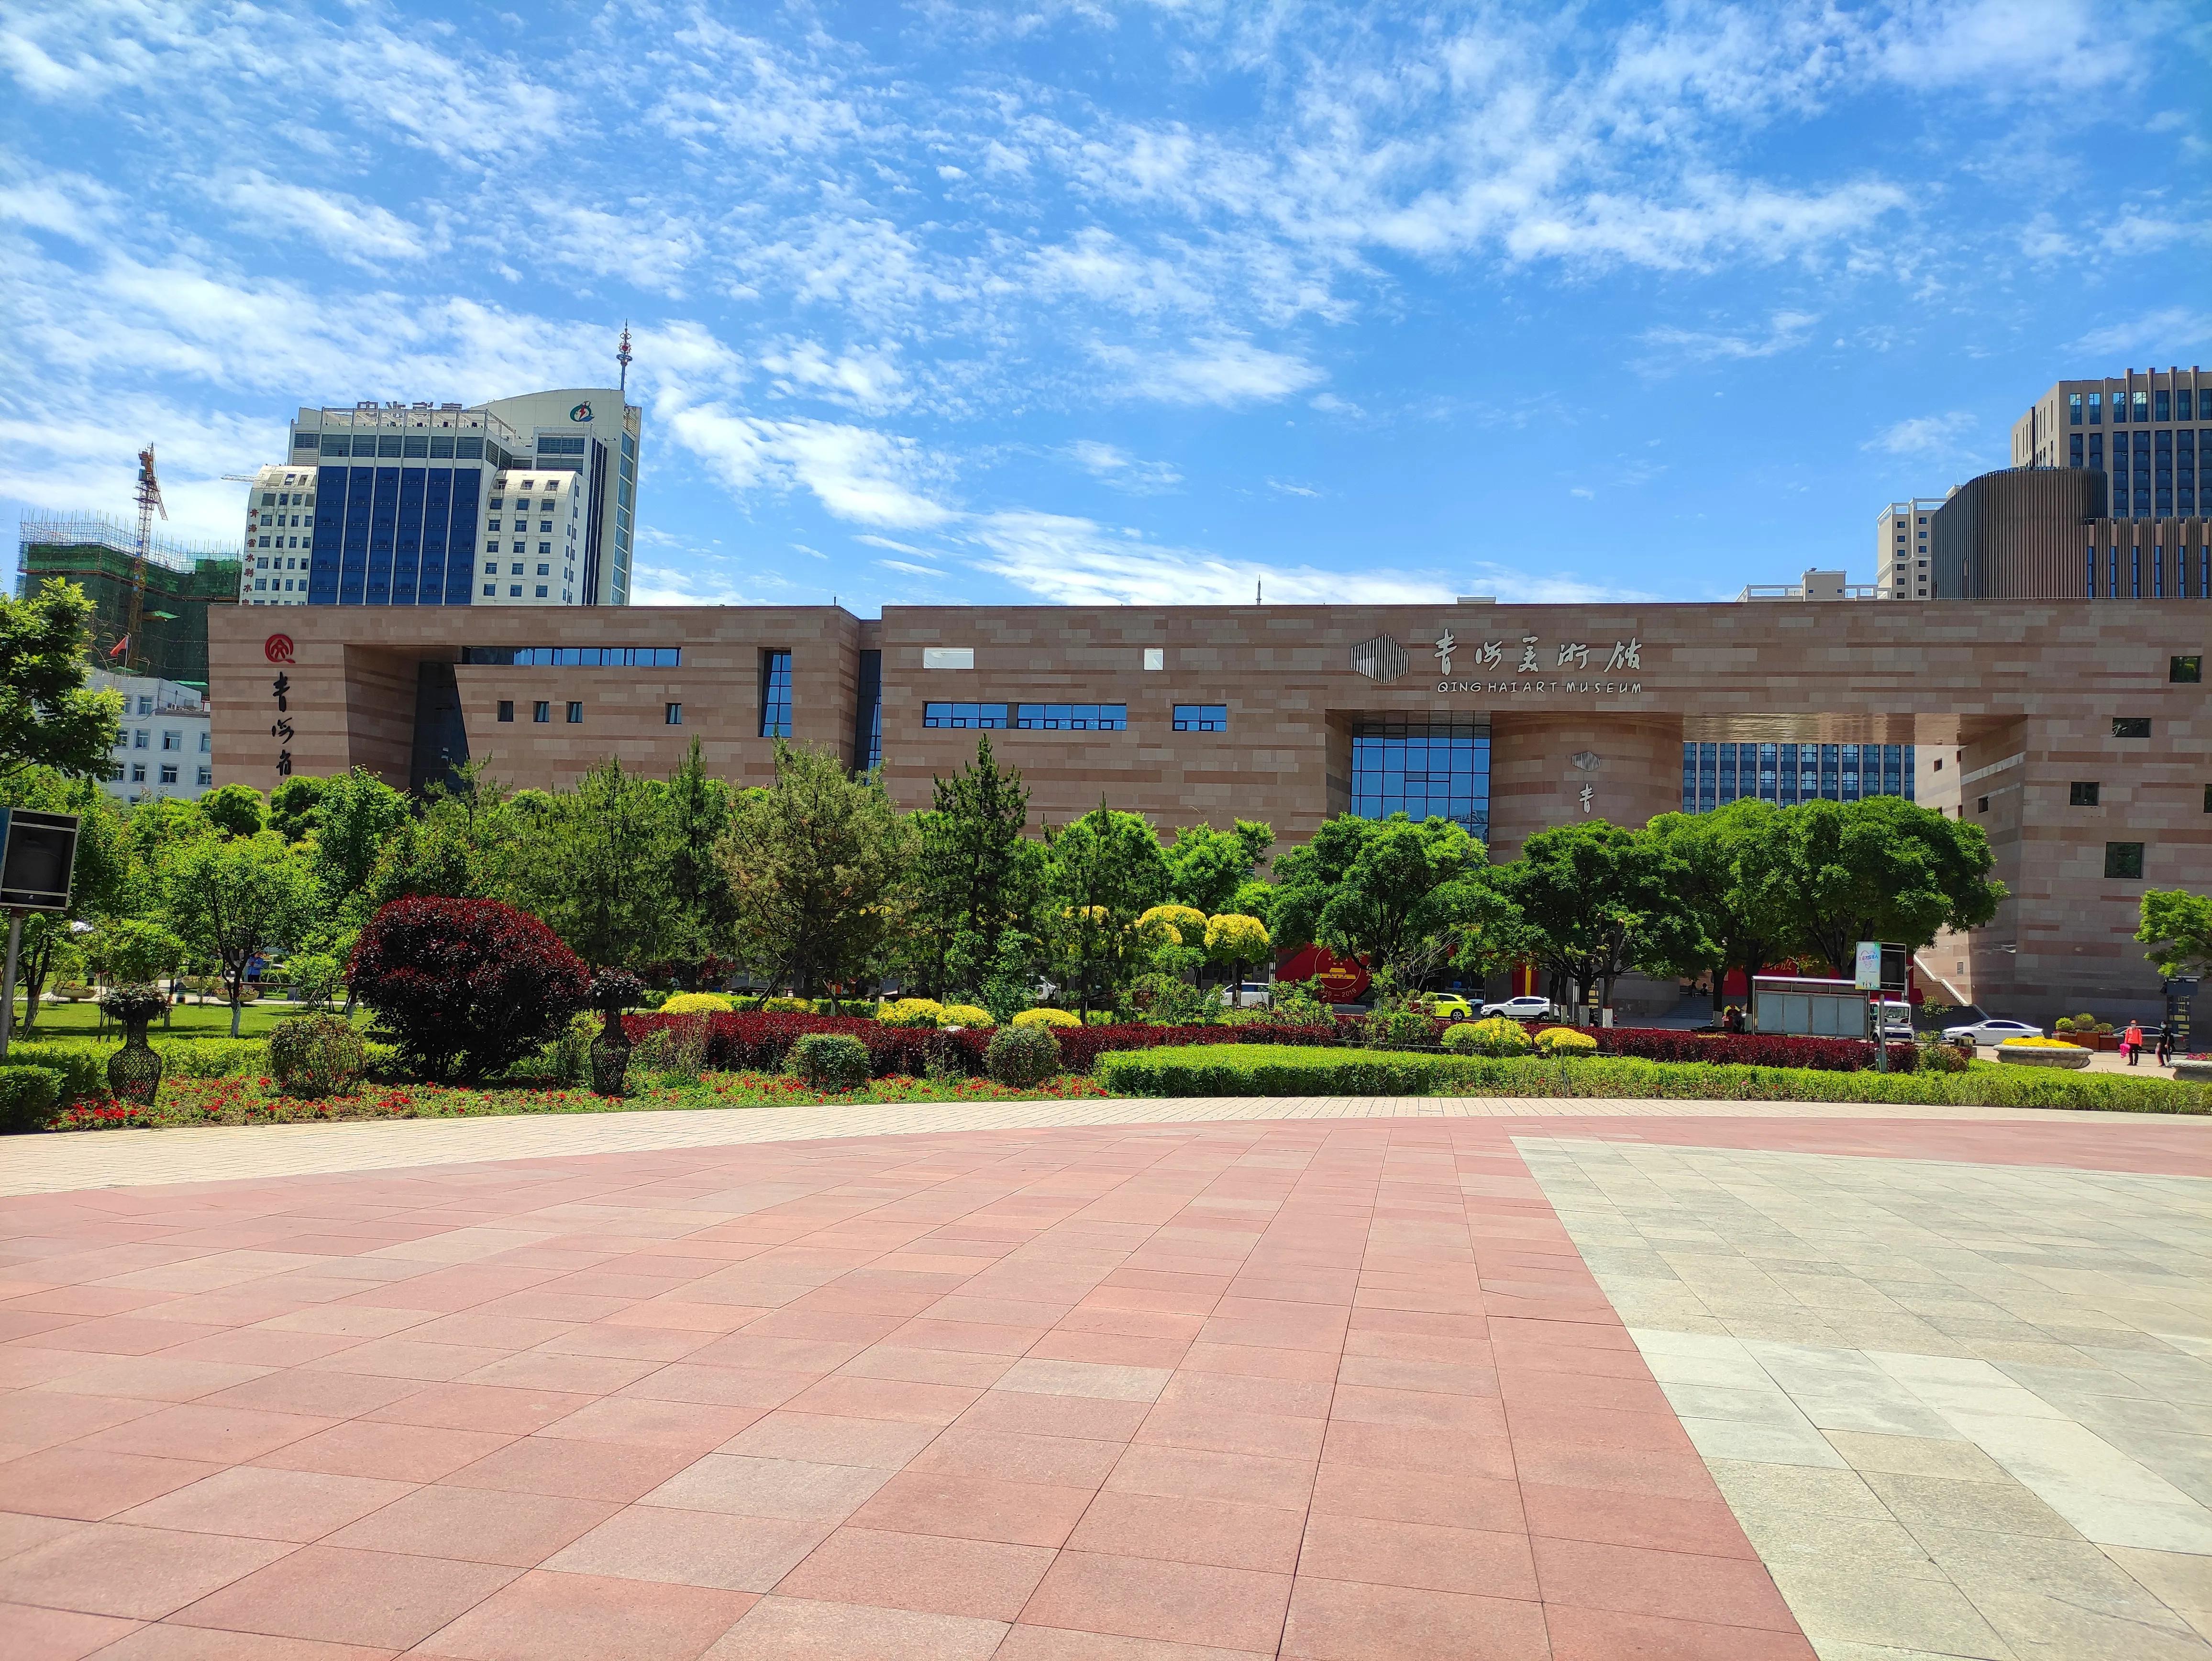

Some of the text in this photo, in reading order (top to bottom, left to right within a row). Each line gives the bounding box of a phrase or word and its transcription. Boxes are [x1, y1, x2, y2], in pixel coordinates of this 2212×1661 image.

[1566, 682, 1642, 694] MUSEUM
[272, 672, 294, 785] 青海省
[1341, 988, 1357, 997] 2019
